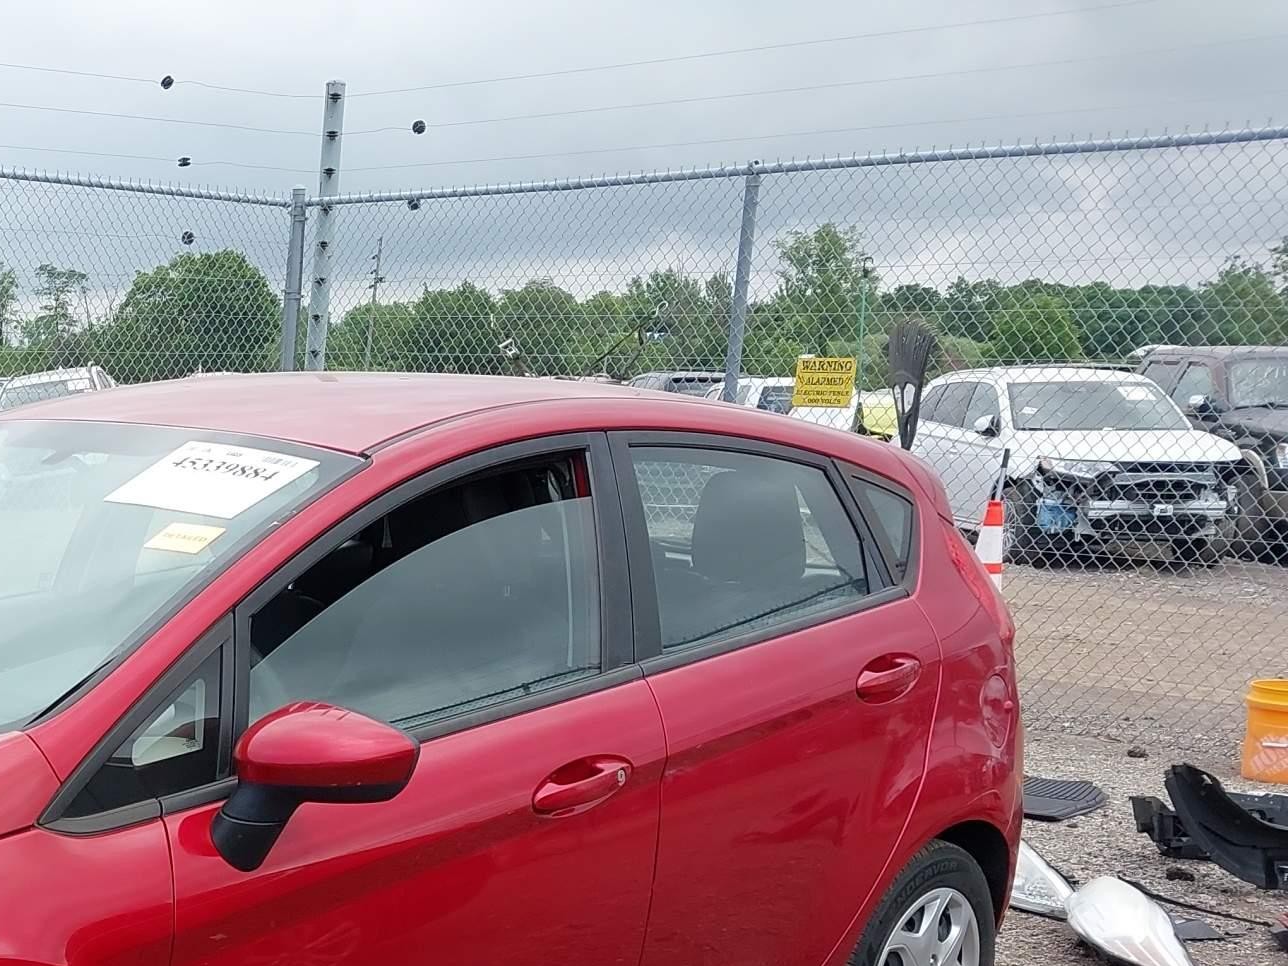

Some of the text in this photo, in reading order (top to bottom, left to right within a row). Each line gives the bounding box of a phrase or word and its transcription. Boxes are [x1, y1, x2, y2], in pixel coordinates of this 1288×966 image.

[802, 360, 853, 372] WARNING
[804, 376, 844, 386] ALARMED
[796, 389, 828, 397] ELECTRIC
[172, 456, 279, 481] 45339884
